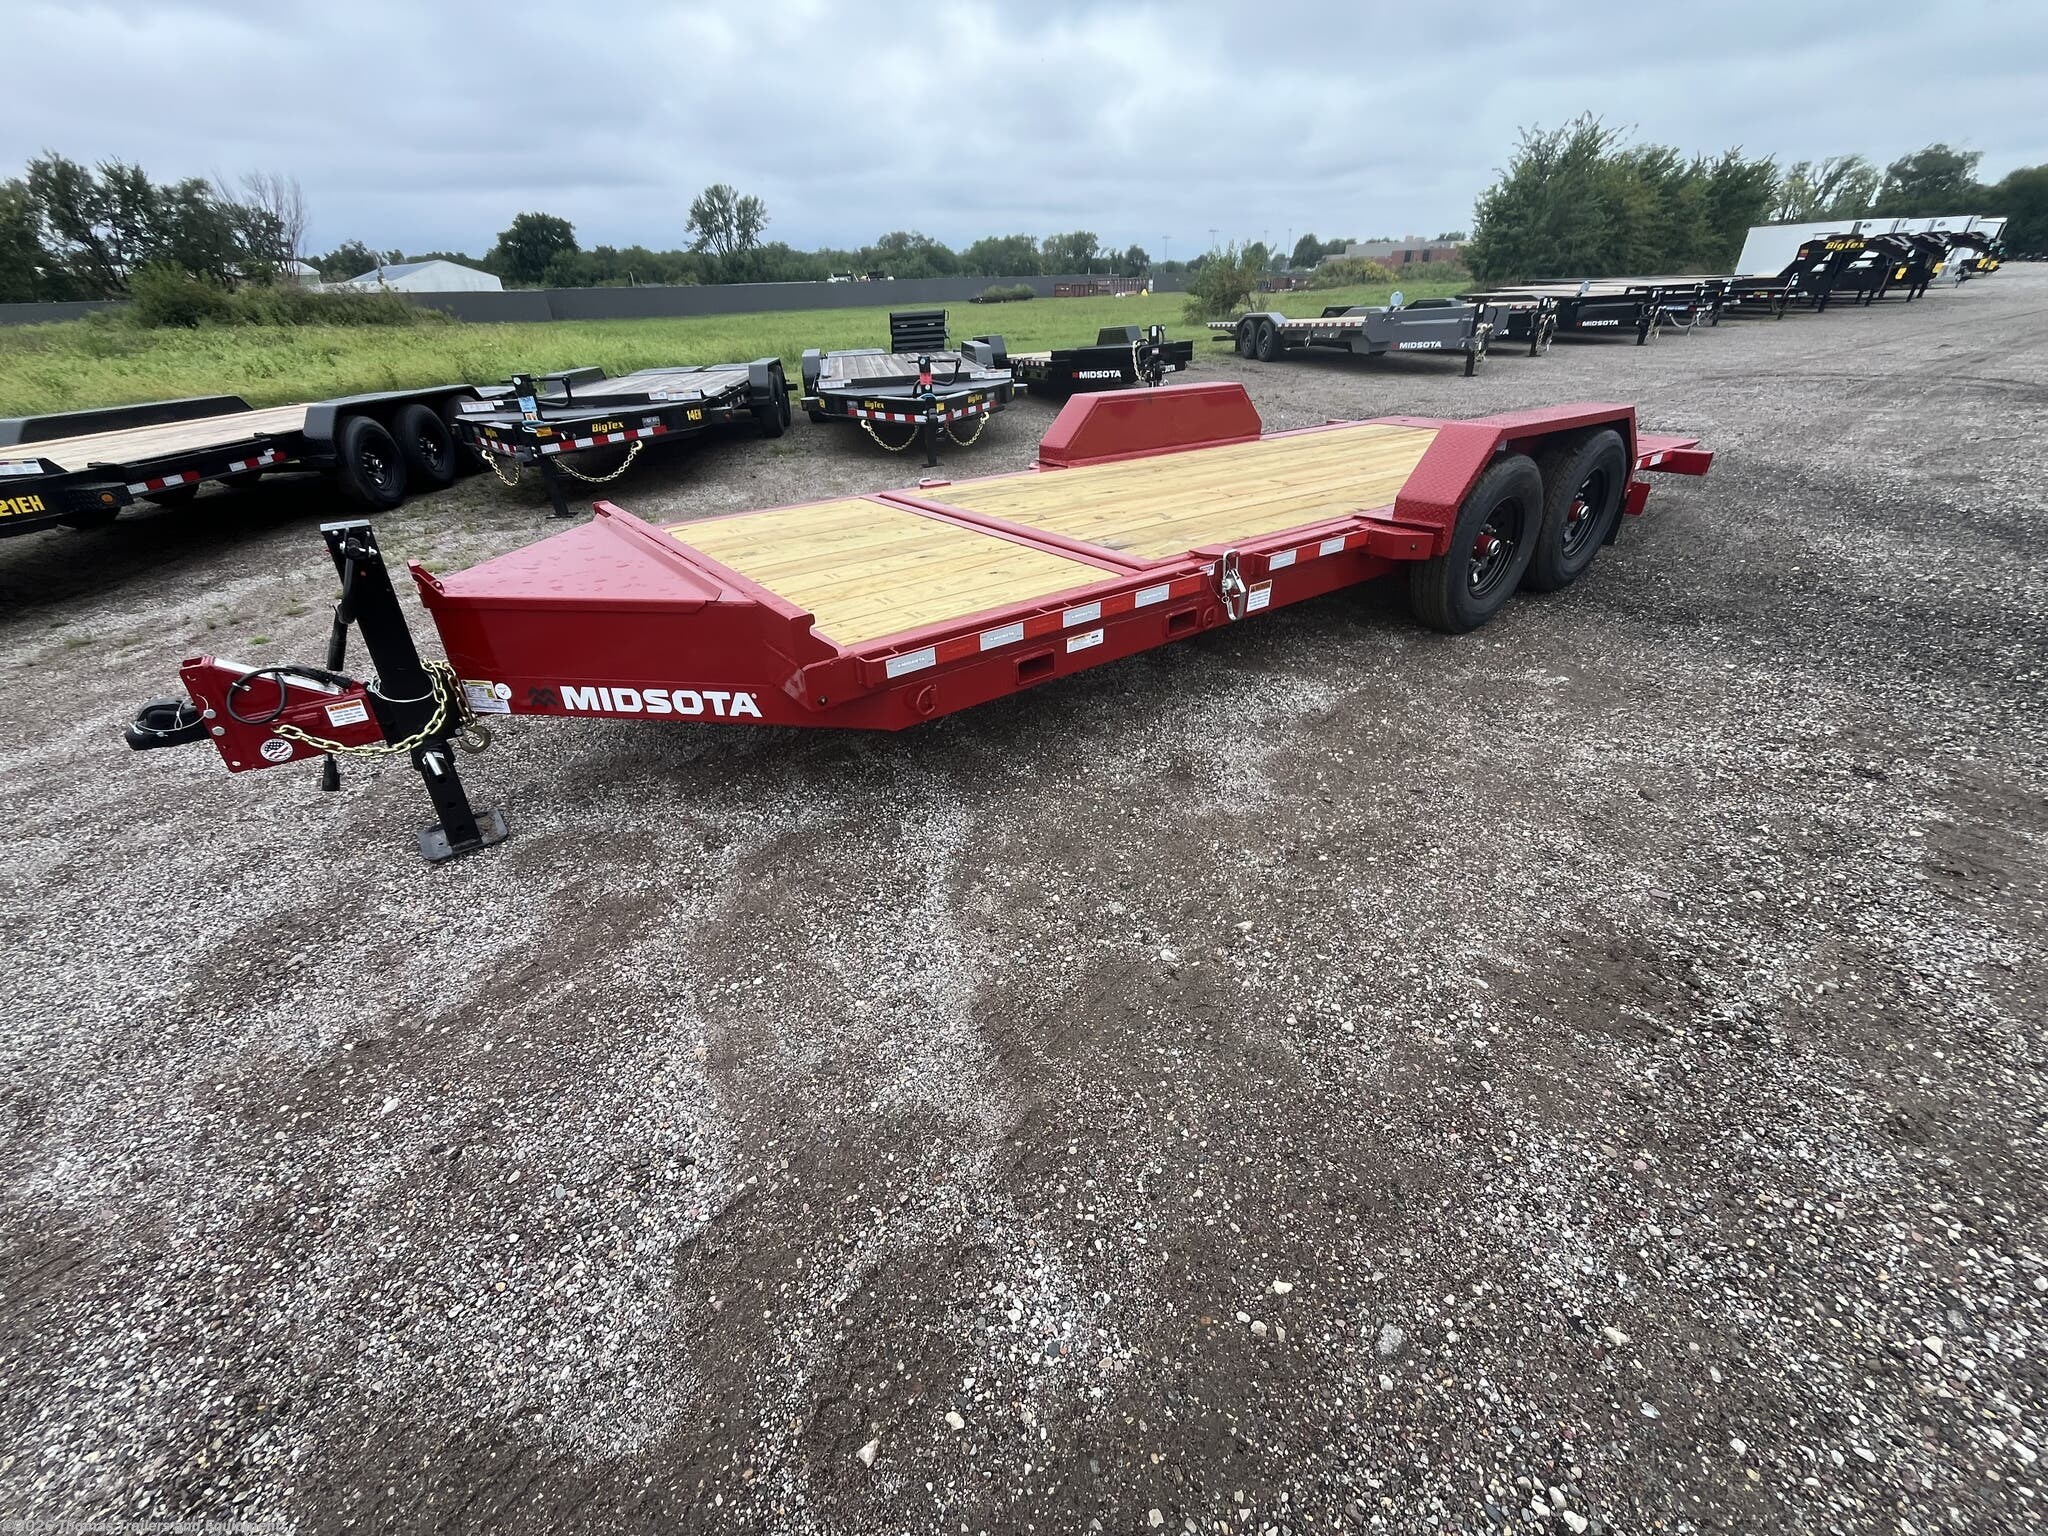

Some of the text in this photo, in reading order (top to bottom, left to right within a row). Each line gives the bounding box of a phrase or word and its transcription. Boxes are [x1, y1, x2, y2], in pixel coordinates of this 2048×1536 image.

[1823, 240, 1867, 251] BigTex
[1400, 340, 1442, 349] MIDSOTA
[1079, 370, 1121, 379] MIDSOTA
[592, 421, 624, 433] BigTex
[559, 686, 763, 718] MIDSOTA
